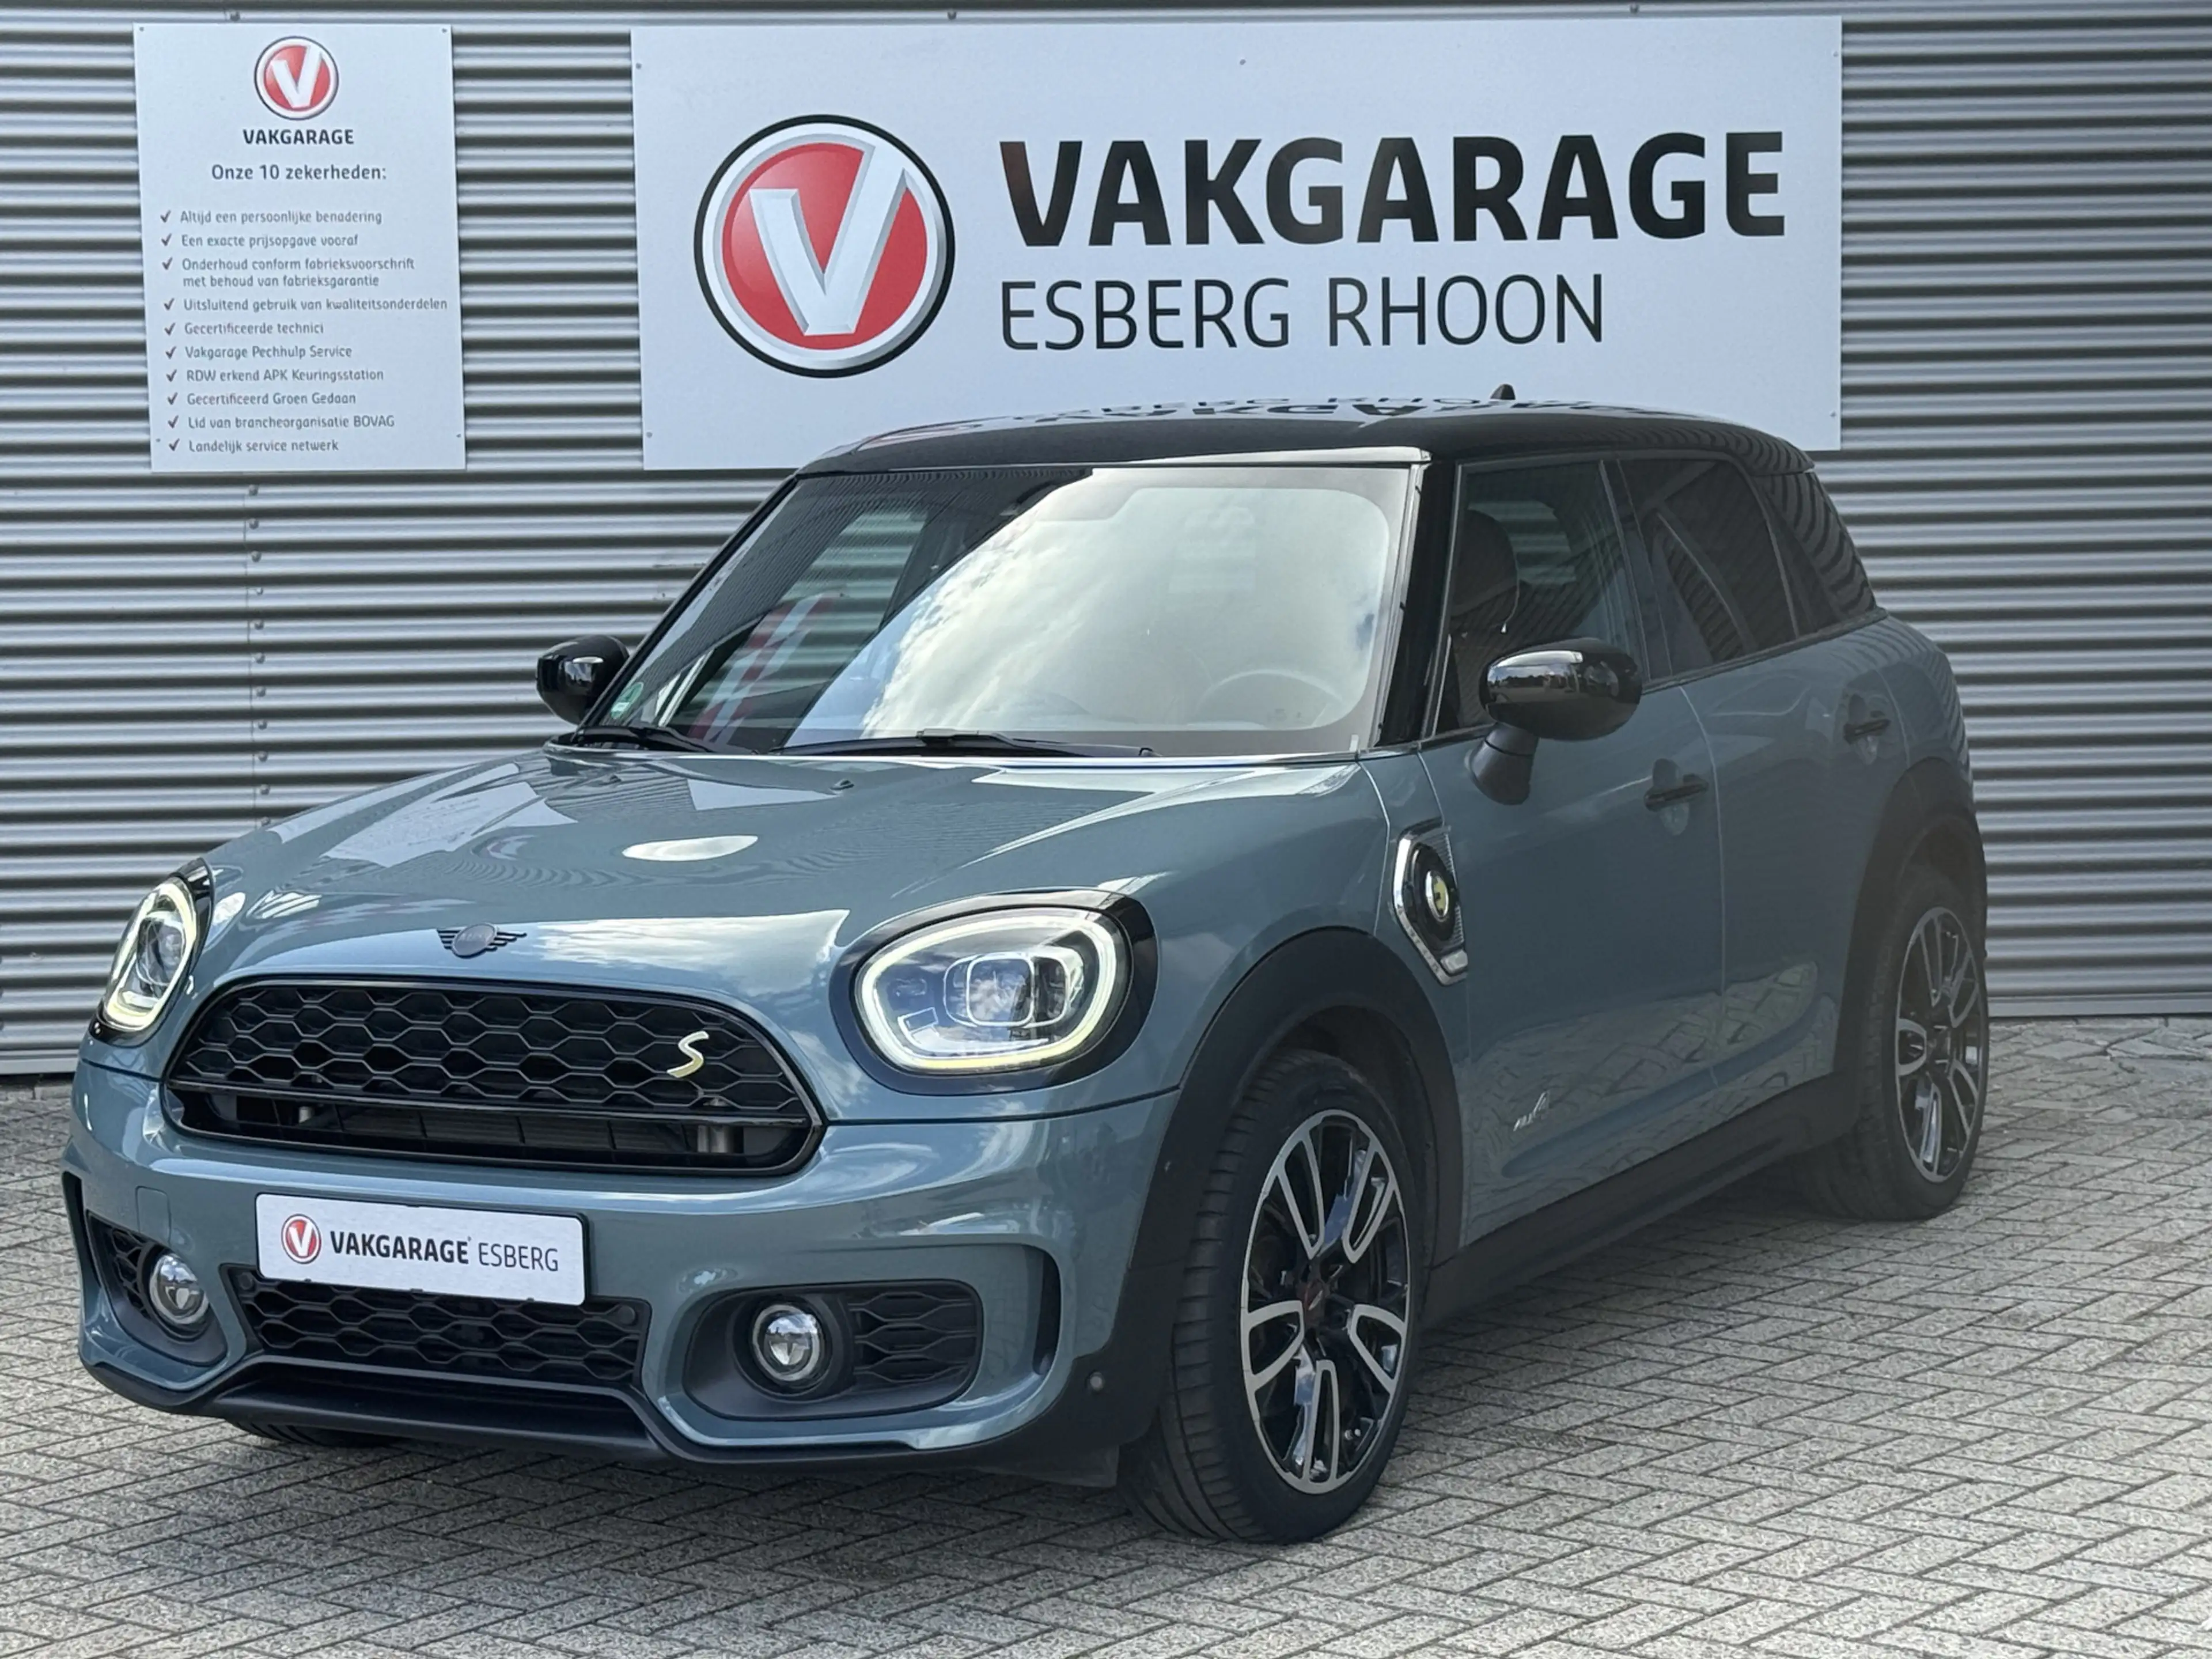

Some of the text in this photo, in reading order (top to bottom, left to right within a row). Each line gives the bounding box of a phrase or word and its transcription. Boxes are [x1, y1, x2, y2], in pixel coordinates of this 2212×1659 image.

[243, 129, 354, 145] VAKGARAGE
[211, 164, 387, 180] Onze 10 zekerheden:
[1000, 132, 1784, 246] VAKGARAGE
[180, 210, 382, 225] Altijd een persoonlijke benadering
[181, 234, 358, 249] Een exacte prijsopgave vooraf
[749, 144, 906, 336] V
[181, 257, 415, 271] Onderhoud conform fabrieksvoorschrift
[183, 275, 379, 289] met behoud van fabrieksgarantie
[183, 297, 448, 313] Uitsluitend gebruik van kwaliteitsonderdelen
[1002, 274, 1601, 350] ESBERG RHOON
[184, 322, 324, 335] Gecertificeerde technici
[184, 344, 353, 361] Vakgarage Pechhulp Service
[186, 368, 384, 383] RDW erkend APK Keuringsstation
[187, 392, 356, 406] Gecertificeerd Groen Gedaan
[188, 414, 395, 430] Lid van brancheorganisatie BOVAG
[188, 439, 339, 454] Landelijk service netwerk
[666, 1031, 709, 1078] S
[331, 1231, 469, 1264] VAKGARAGE
[479, 1243, 558, 1271] ESBERG
